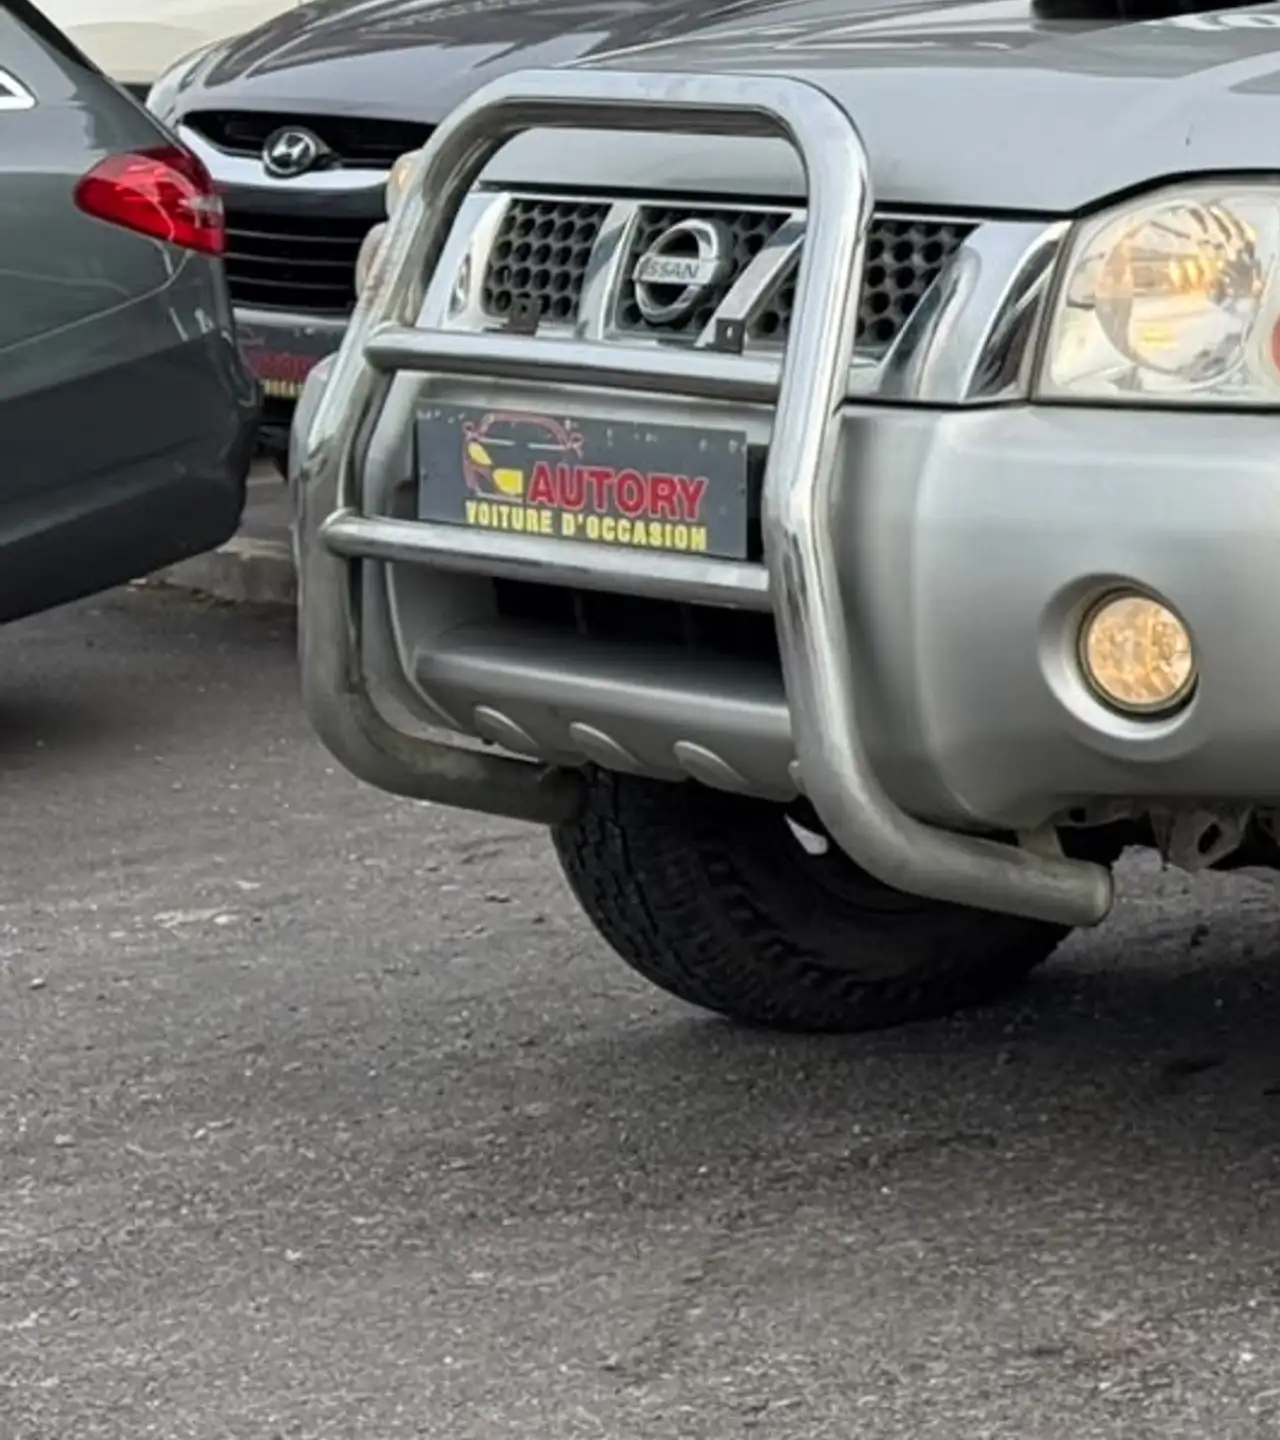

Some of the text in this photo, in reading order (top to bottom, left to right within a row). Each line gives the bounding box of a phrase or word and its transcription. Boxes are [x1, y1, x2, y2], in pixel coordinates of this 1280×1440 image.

[639, 257, 700, 280] ISSAN
[526, 461, 708, 522] AUTORY
[465, 500, 707, 552] VOITURE D'OCCASION
